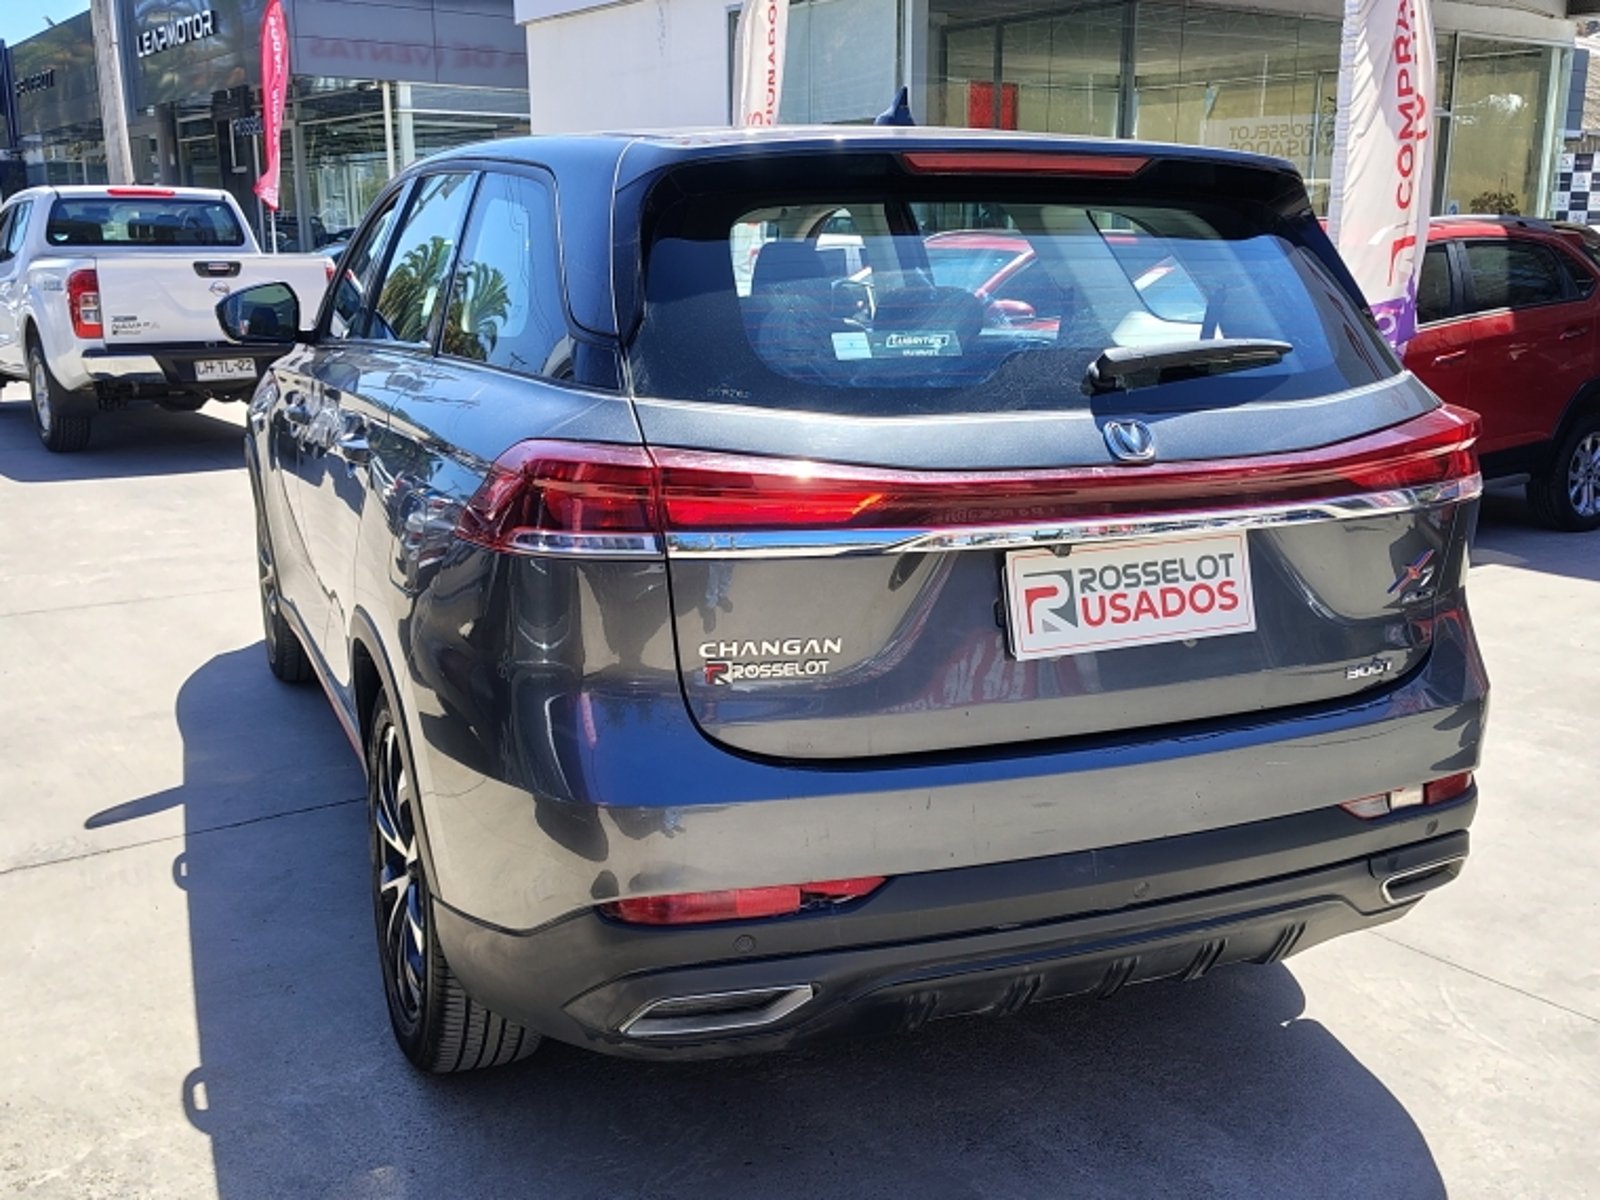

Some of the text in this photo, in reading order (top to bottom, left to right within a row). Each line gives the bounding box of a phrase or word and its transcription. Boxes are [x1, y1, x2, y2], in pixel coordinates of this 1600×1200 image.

[1079, 553, 1235, 594] ROSSELOT
[1081, 580, 1239, 629] USADOS
[699, 638, 842, 658] CHANGAN
[733, 660, 830, 679] ROSSELOT
